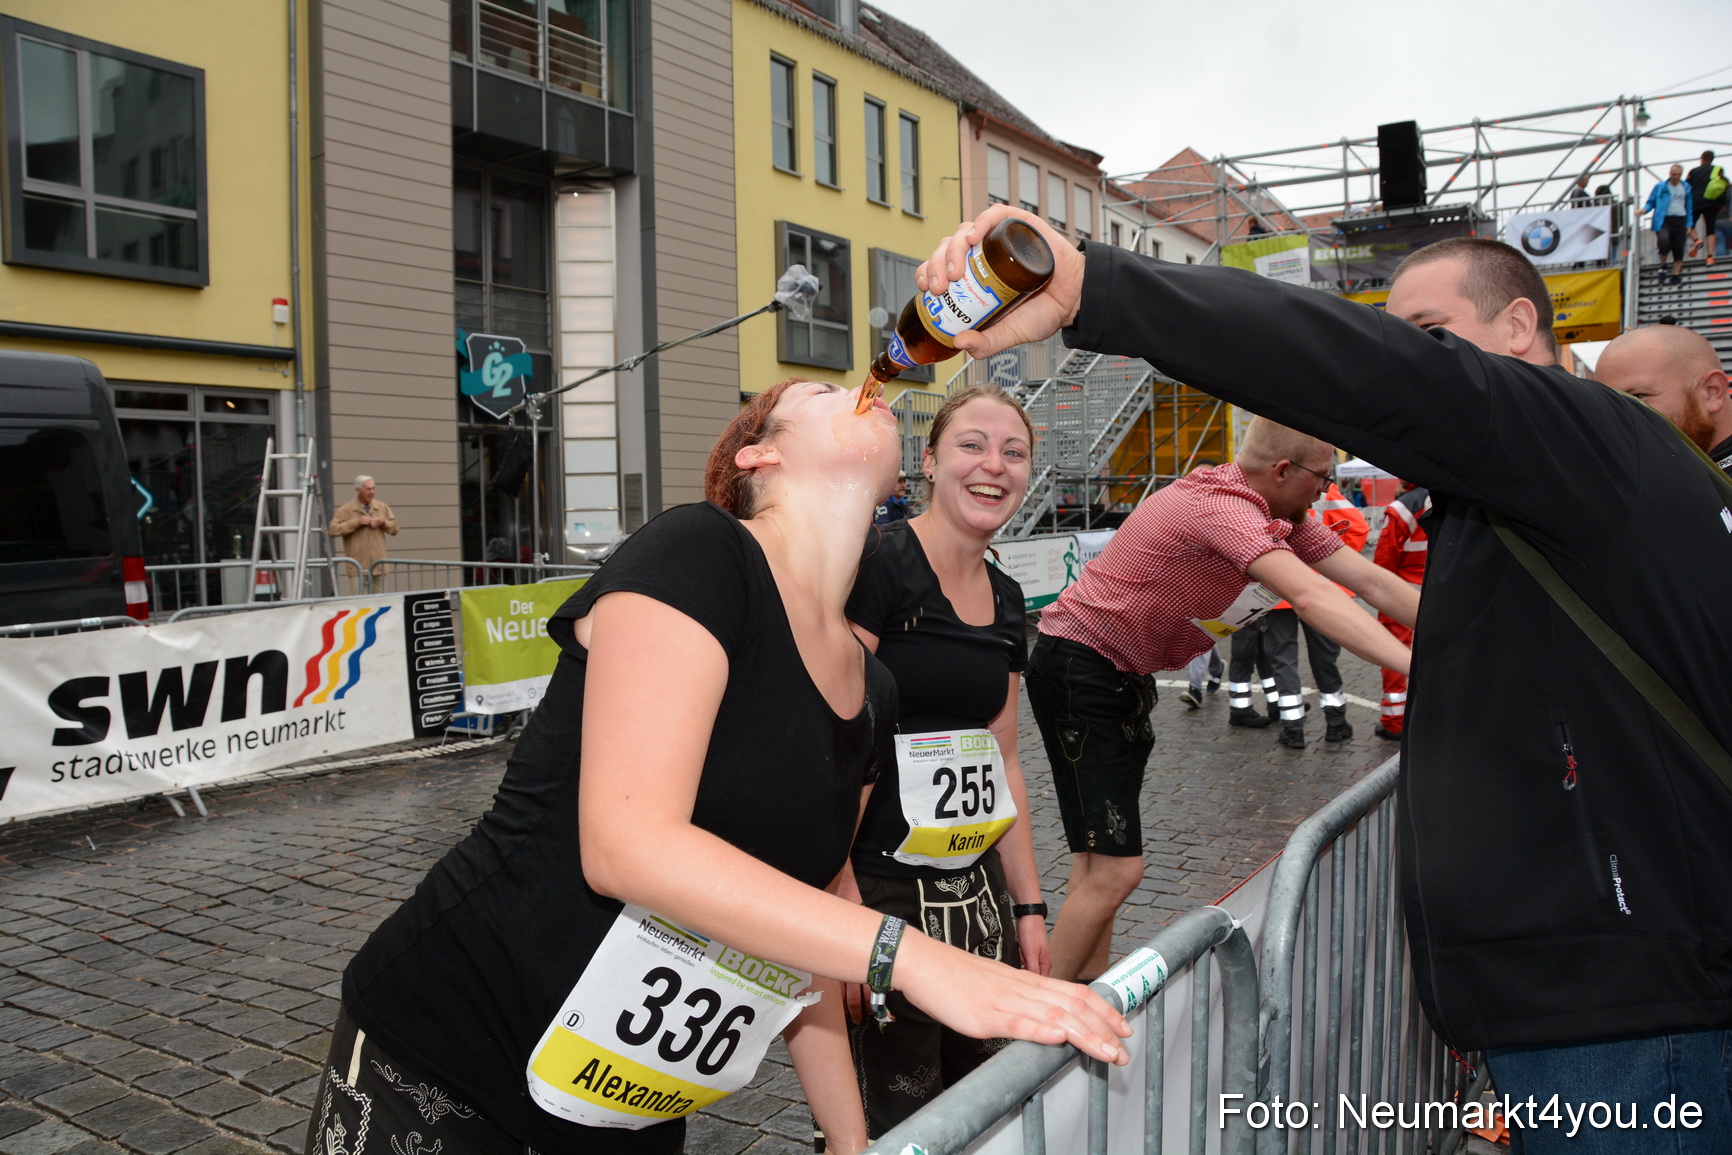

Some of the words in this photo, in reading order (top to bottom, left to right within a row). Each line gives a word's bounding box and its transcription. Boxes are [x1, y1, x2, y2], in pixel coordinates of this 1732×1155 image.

[1315, 245, 1374, 260] BOCK
[482, 352, 513, 398] G2
[510, 600, 535, 615] Der
[48, 649, 288, 746] swn
[50, 738, 216, 783] stadtwerke
[227, 708, 347, 754] neumarkt
[909, 748, 955, 758] NeuerMarkt
[933, 764, 995, 819] 255
[948, 831, 985, 851] Karin
[638, 918, 706, 962] NeuerMarkt
[709, 967, 736, 987] inspired
[745, 984, 763, 1000] smart
[719, 948, 798, 997] BOCK
[566, 1012, 580, 1028] D
[615, 966, 756, 1076] 336
[571, 1058, 695, 1115] Alexandra
